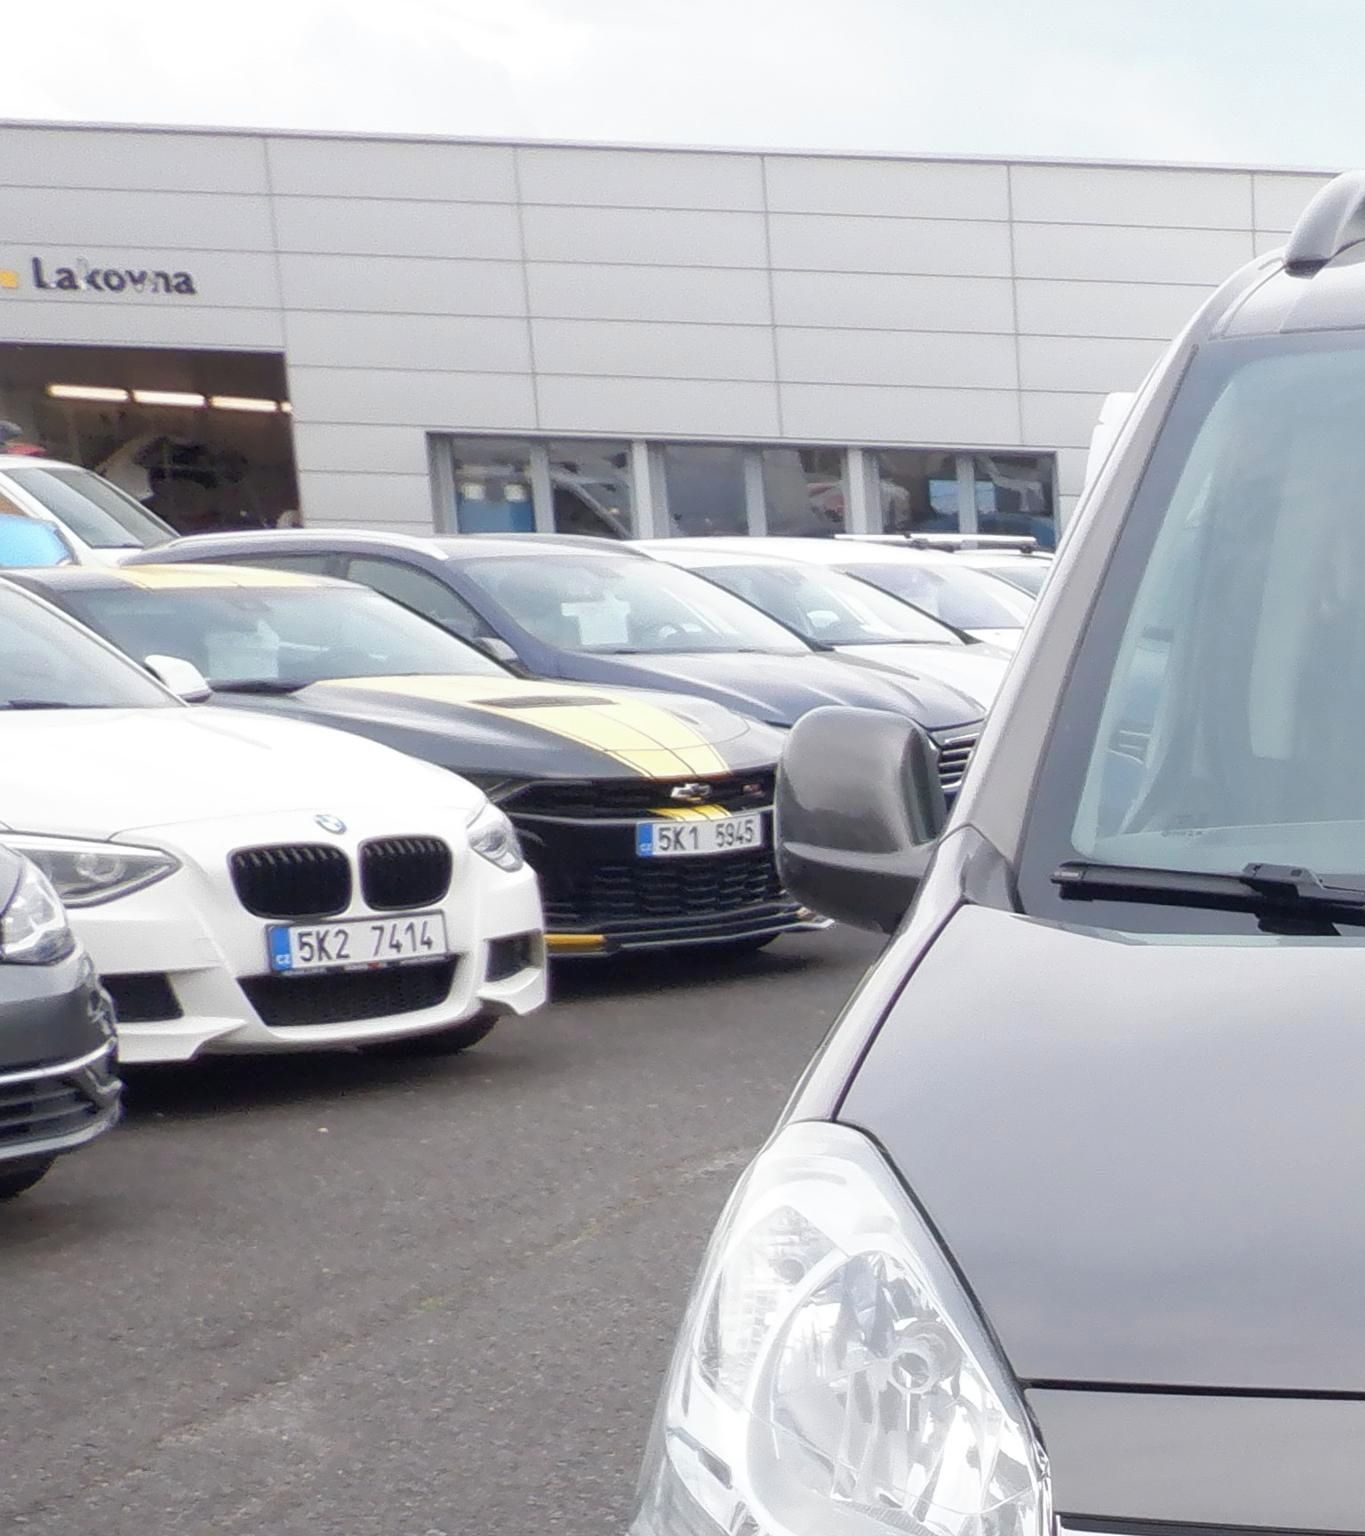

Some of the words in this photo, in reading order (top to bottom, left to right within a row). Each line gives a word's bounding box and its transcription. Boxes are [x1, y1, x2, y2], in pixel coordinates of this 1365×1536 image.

[32, 256, 197, 295] Lakovna
[658, 825, 699, 852] 5K1
[715, 819, 754, 848] 5945
[275, 953, 290, 965] CZ
[297, 929, 350, 962] 5K2
[371, 921, 433, 957] 7414
